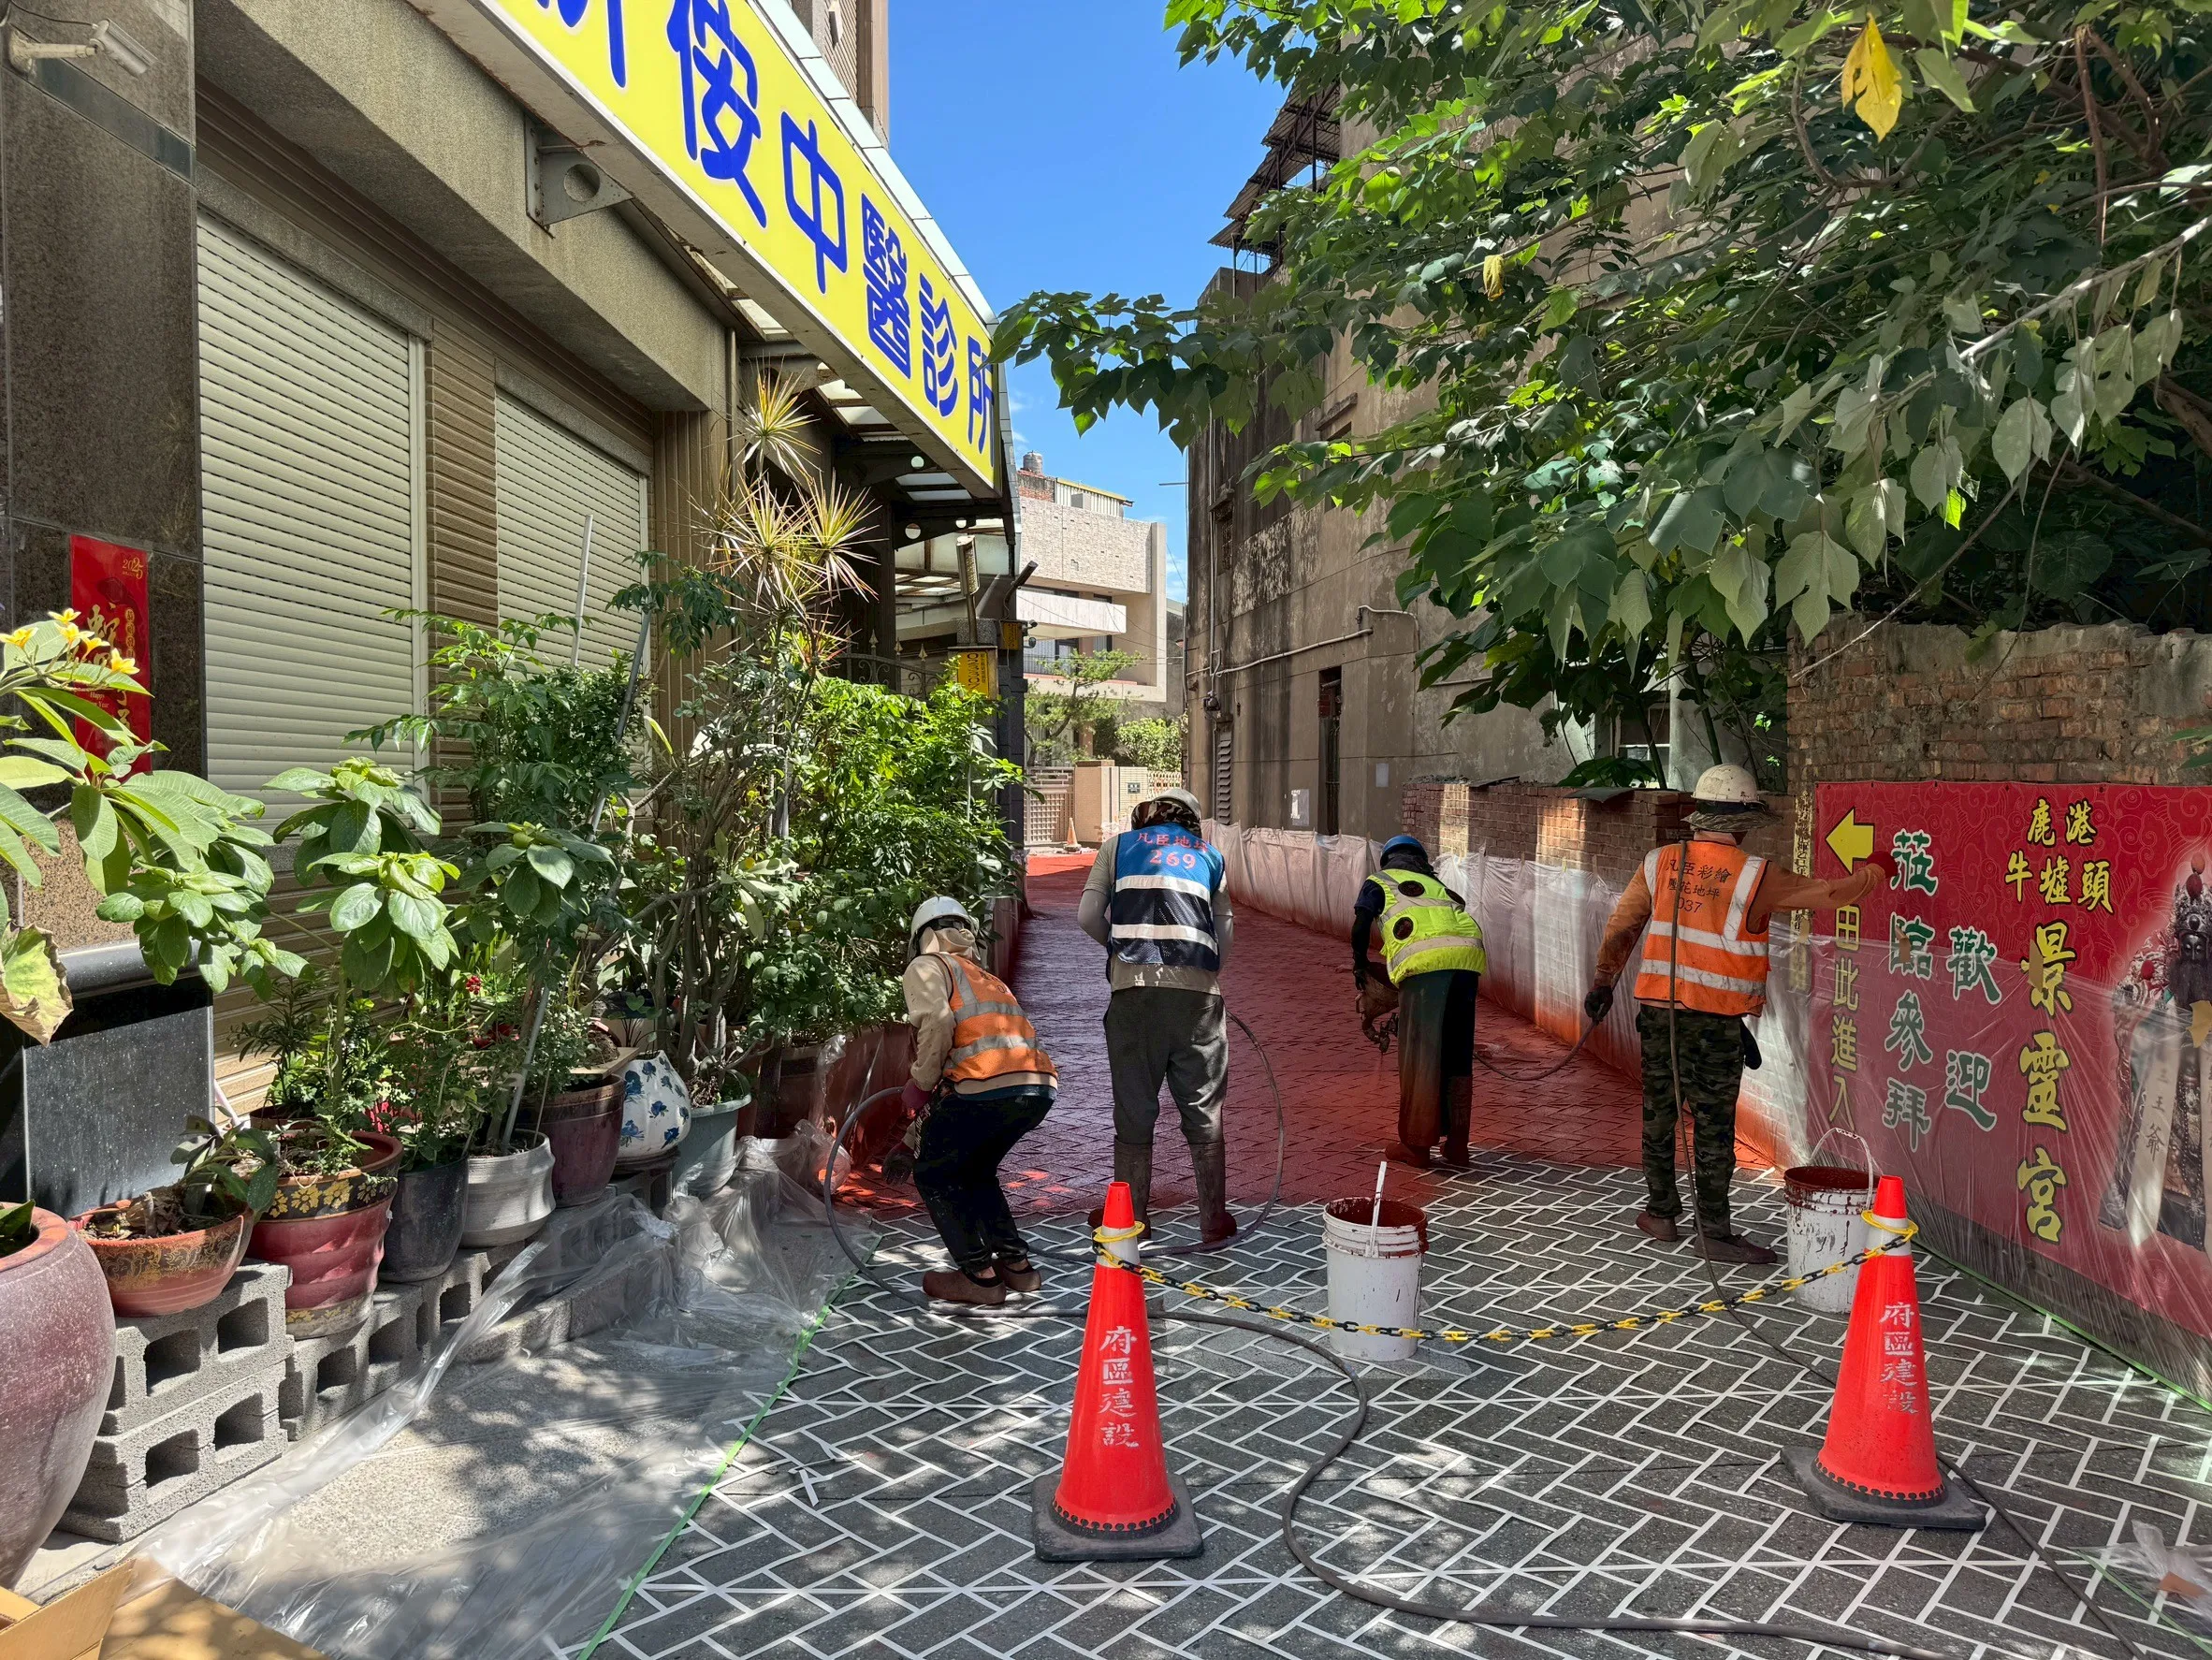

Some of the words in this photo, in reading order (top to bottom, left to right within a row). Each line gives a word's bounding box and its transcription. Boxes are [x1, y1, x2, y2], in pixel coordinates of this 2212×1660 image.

[123, 558, 143, 579] 2025
[2027, 798, 2098, 847] 鹿港
[1150, 850, 1196, 869] 269
[2004, 850, 2115, 914] 牛墟頭
[1678, 898, 1703, 913] 037
[1944, 925, 2001, 1132] 歡迎
[2016, 921, 2078, 1245] 景靈宮
[1099, 1325, 1140, 1449] 府區建設
